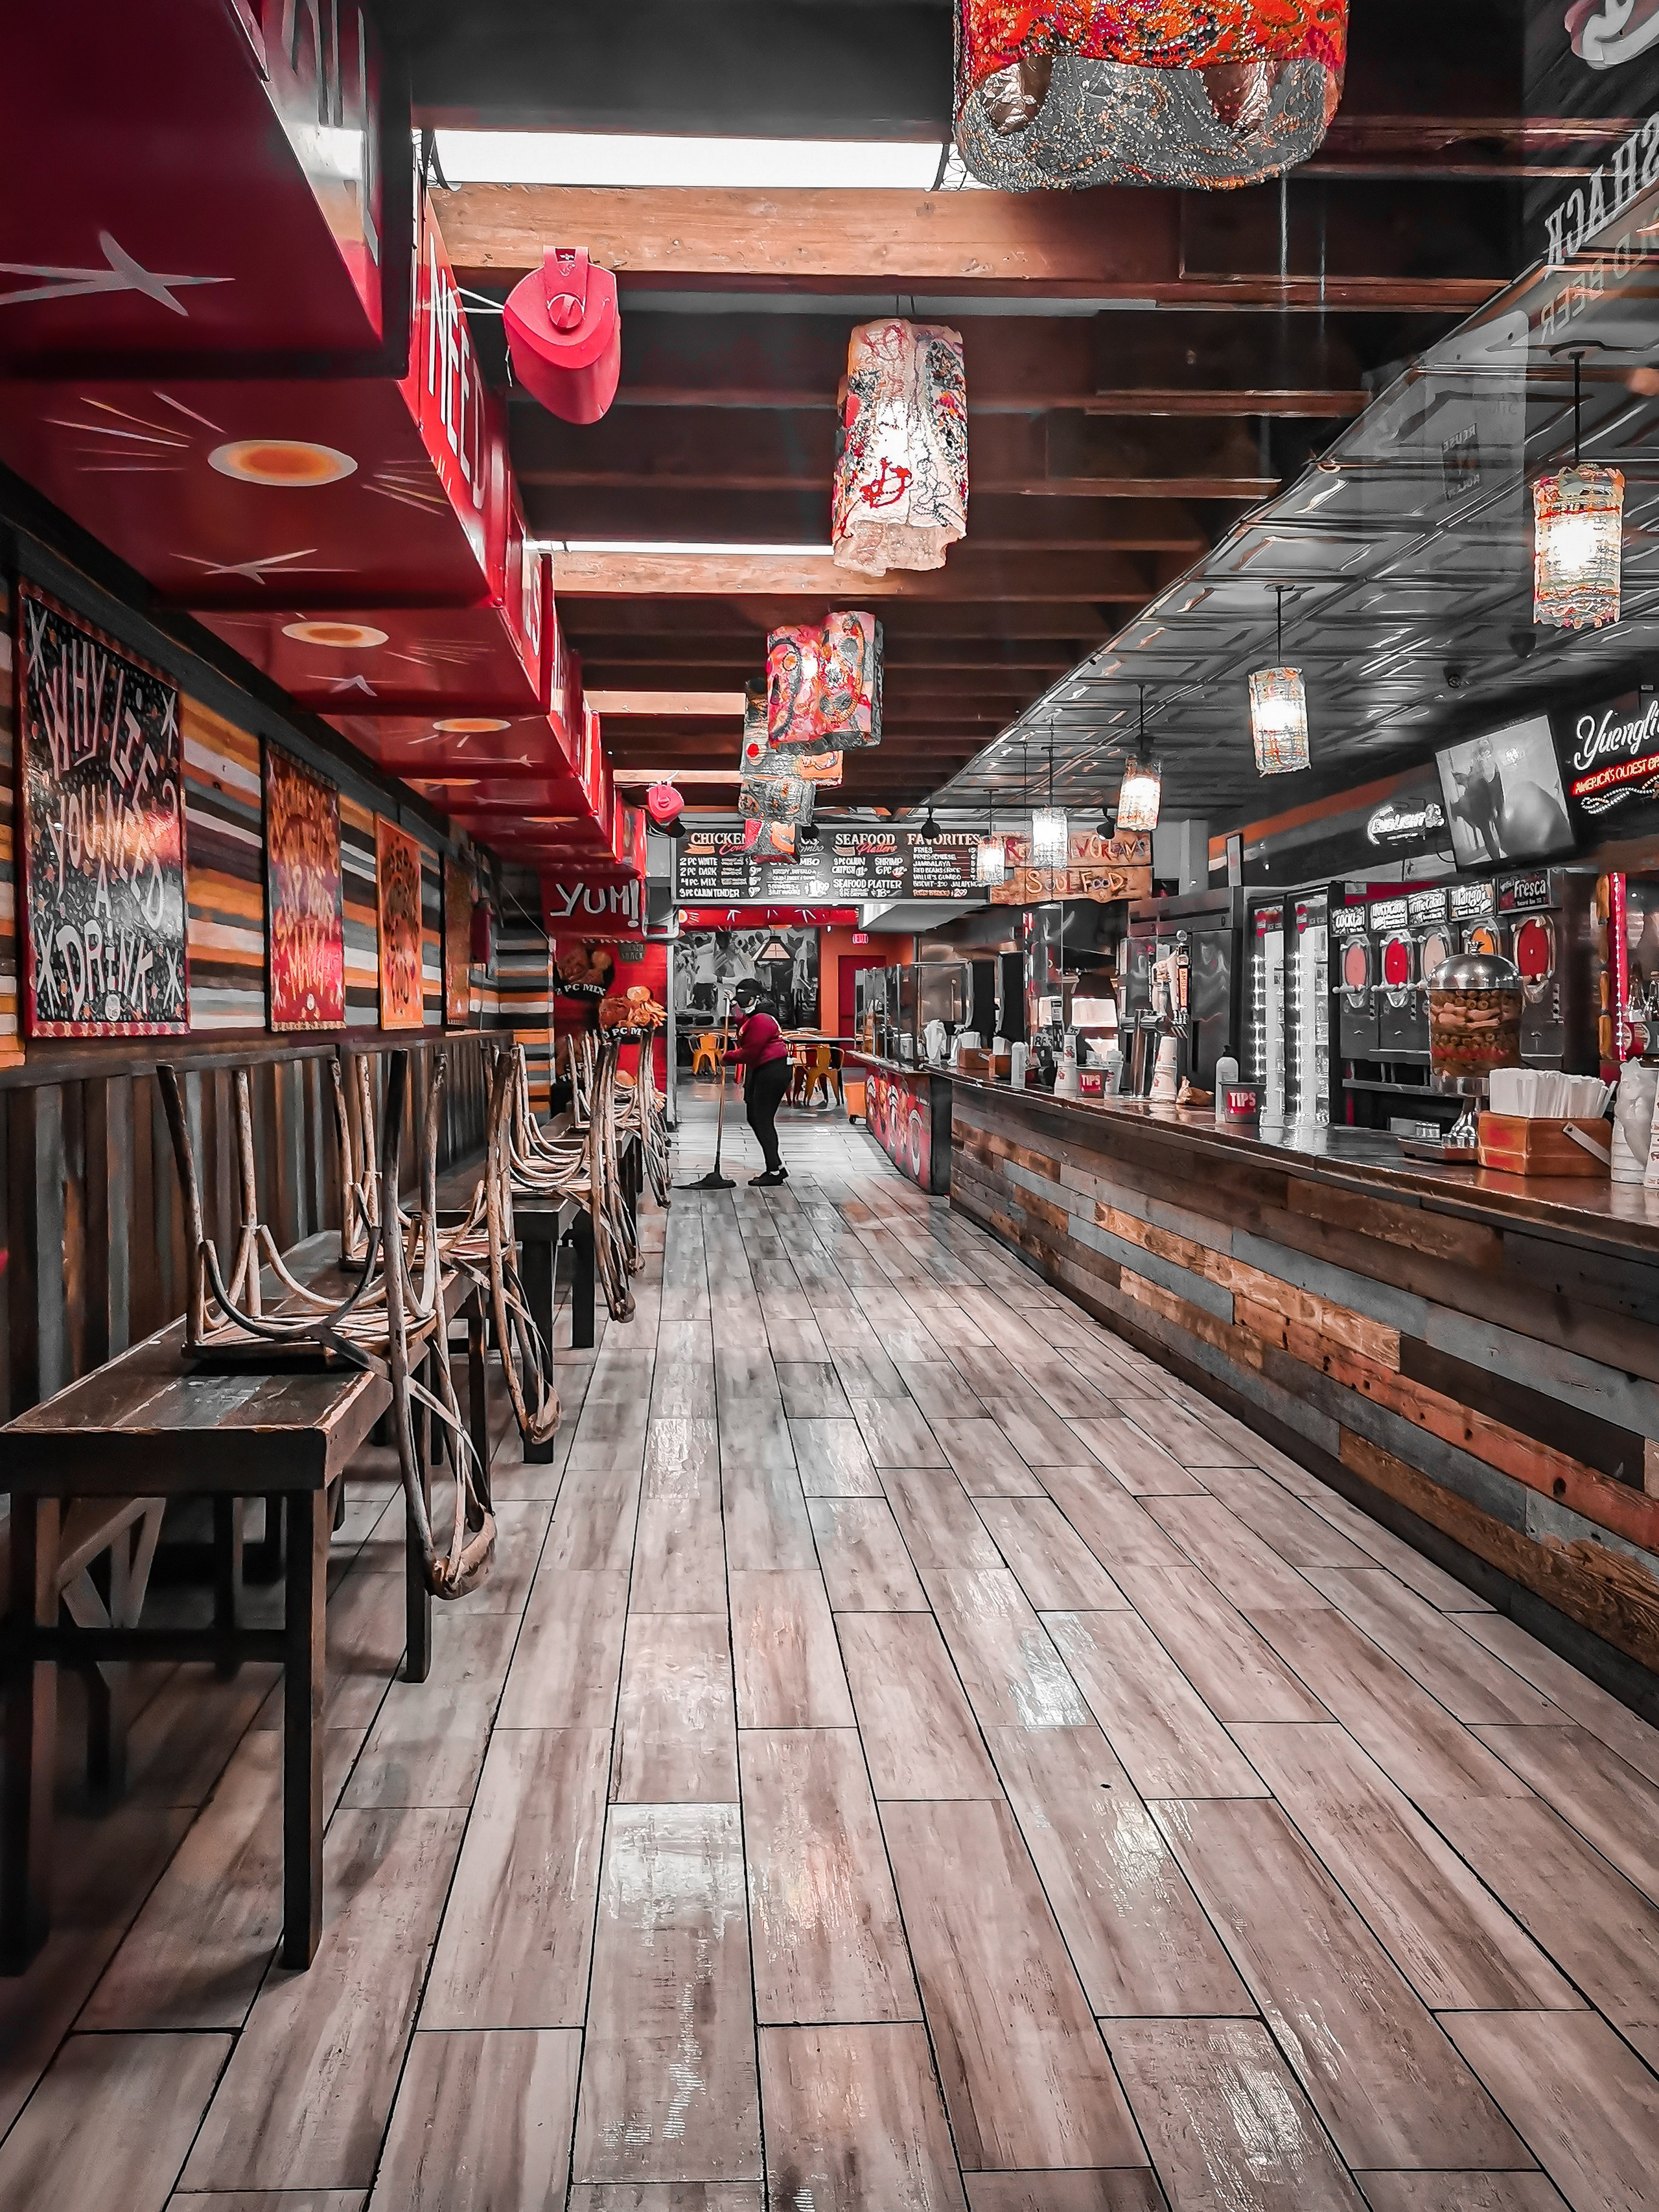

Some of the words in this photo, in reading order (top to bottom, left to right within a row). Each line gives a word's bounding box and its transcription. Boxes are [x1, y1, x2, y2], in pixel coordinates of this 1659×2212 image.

[39, 638, 108, 780] WHY
[1574, 700, 1659, 770] Yuengli
[1575, 767, 1615, 794] AMERICA'S
[1616, 759, 1647, 780] OLDEST
[46, 784, 96, 903] YOU
[835, 833, 895, 845] SEAFOOD
[875, 857, 903, 866] SHRIMP
[680, 867, 687, 876] 2
[687, 867, 696, 876] PC
[699, 867, 717, 876] DARK
[94, 856, 111, 919] A
[701, 878, 717, 886] MIX
[833, 879, 866, 888] SEAFOOD
[868, 879, 902, 889] PLATTER
[1026, 870, 1075, 894] SOUL
[1079, 872, 1124, 892] FOOD
[1514, 879, 1546, 898] Fresca
[679, 888, 685, 897] 3
[686, 888, 693, 897] PC
[713, 888, 740, 898] TENDER
[550, 879, 639, 927] YUM!
[564, 983, 580, 992] PC
[583, 983, 607, 997] MIX
[612, 1027, 627, 1036] PC
[1082, 1074, 1100, 1086] TIPS
[1230, 1092, 1257, 1107] TIPS
